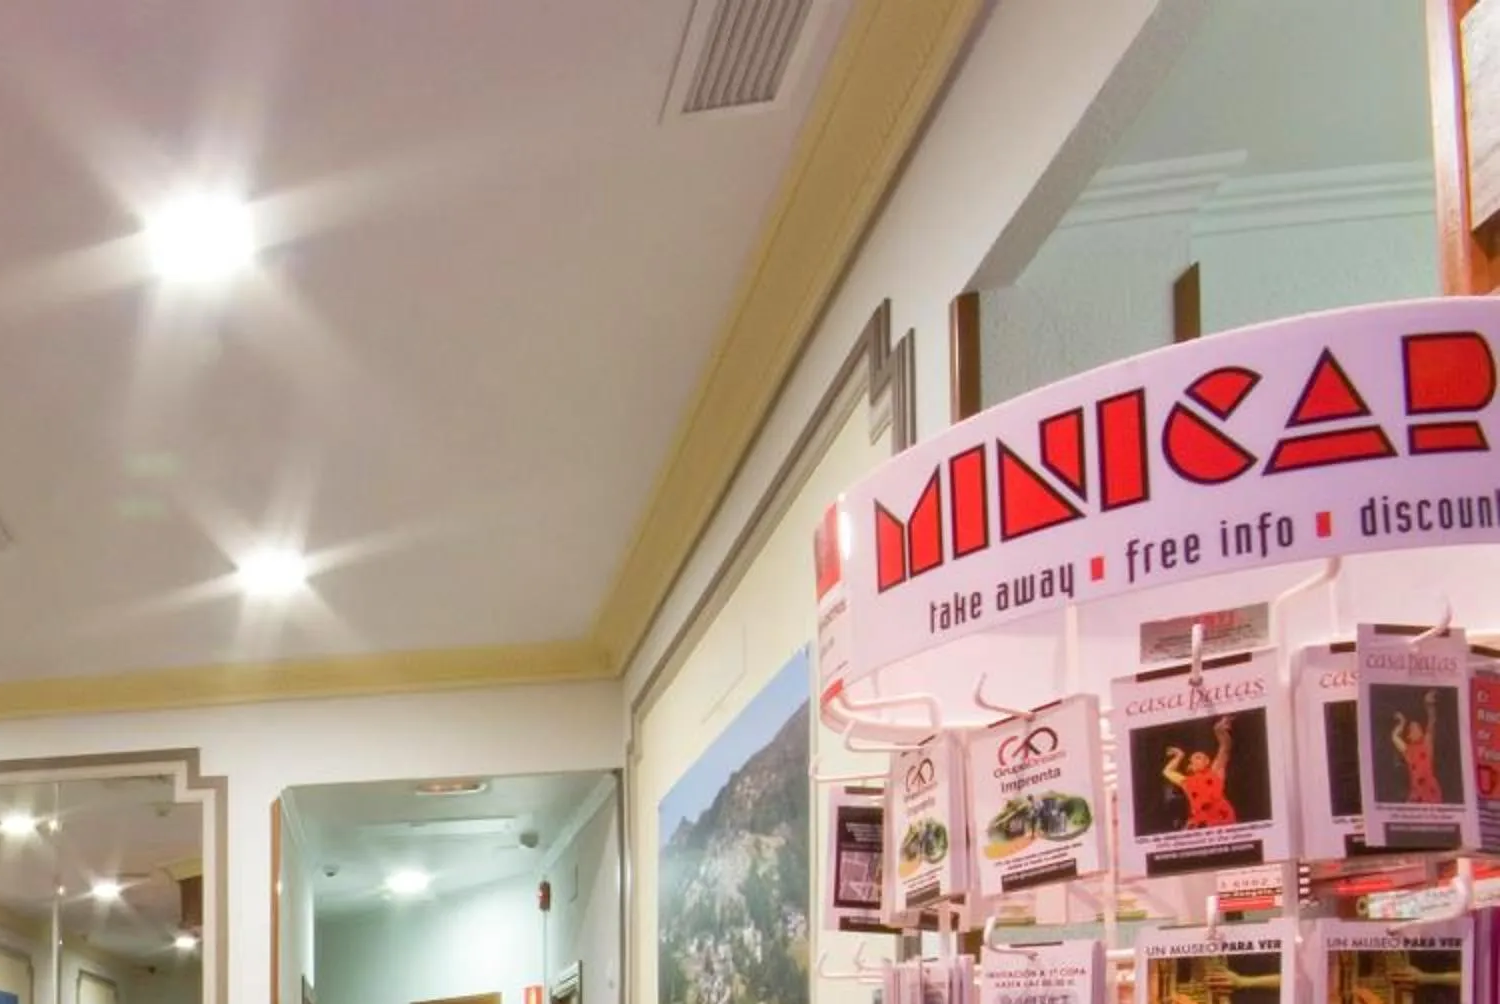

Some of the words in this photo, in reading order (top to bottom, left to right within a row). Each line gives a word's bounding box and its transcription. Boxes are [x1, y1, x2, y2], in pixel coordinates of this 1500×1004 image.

[930, 591, 982, 633] take
[996, 563, 1074, 611] away
[1125, 527, 1201, 583] free
[1220, 512, 1294, 557] info
[1001, 767, 1061, 794] Imprenta
[1221, 940, 1254, 952] PARA
[1258, 939, 1282, 950] VER
[1403, 937, 1436, 948] PARA
[1439, 937, 1463, 948] VER
